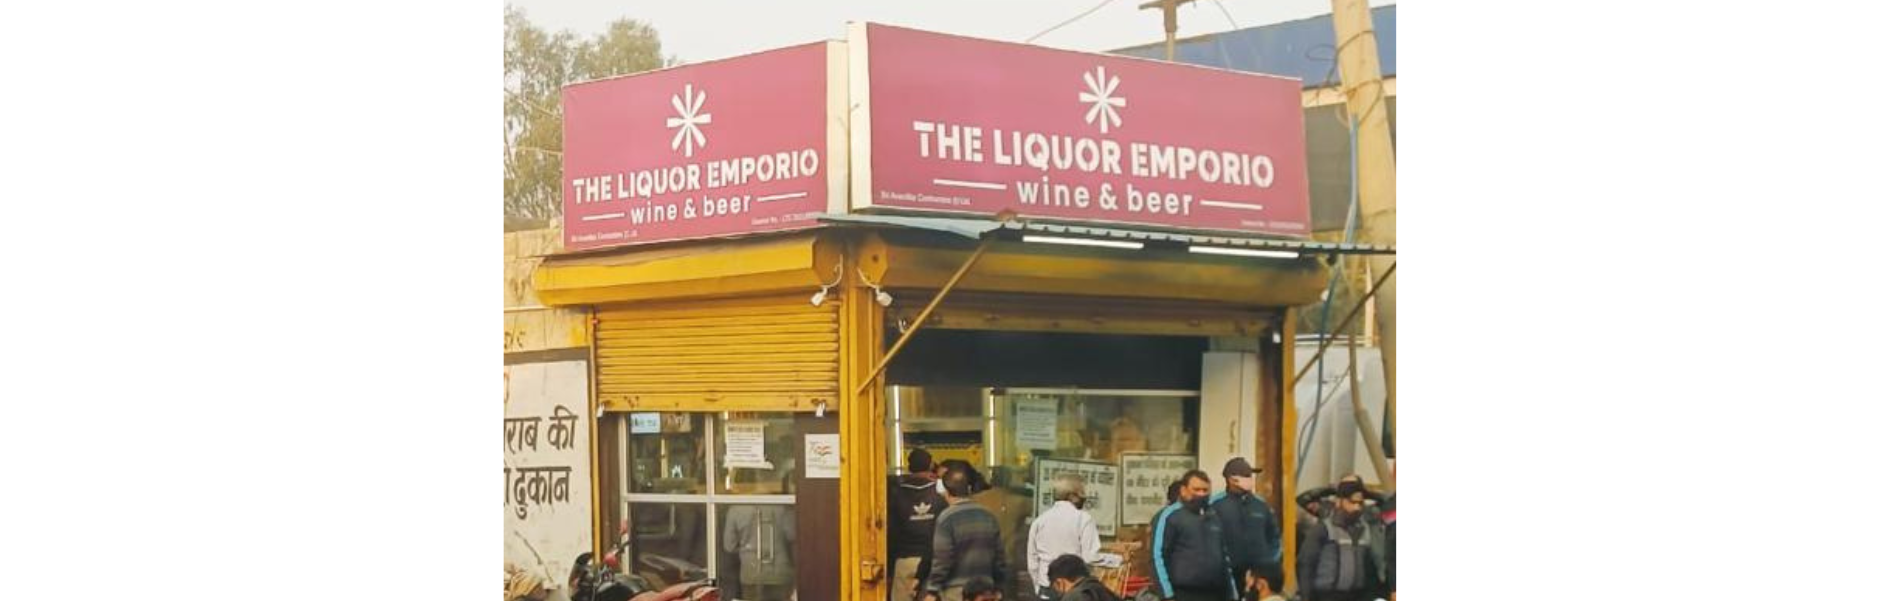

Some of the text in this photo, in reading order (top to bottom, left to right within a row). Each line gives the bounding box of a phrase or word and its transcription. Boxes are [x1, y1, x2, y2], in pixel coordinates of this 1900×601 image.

[572, 148, 819, 204] THE LIQUOR EMPORIO
[912, 121, 1275, 188] THE LIQUOR EMPORIO
[631, 194, 751, 225] wine & beer
[1016, 175, 1193, 216] wine & beer
[504, 404, 579, 454] राब की
[513, 466, 573, 520] दुकान
